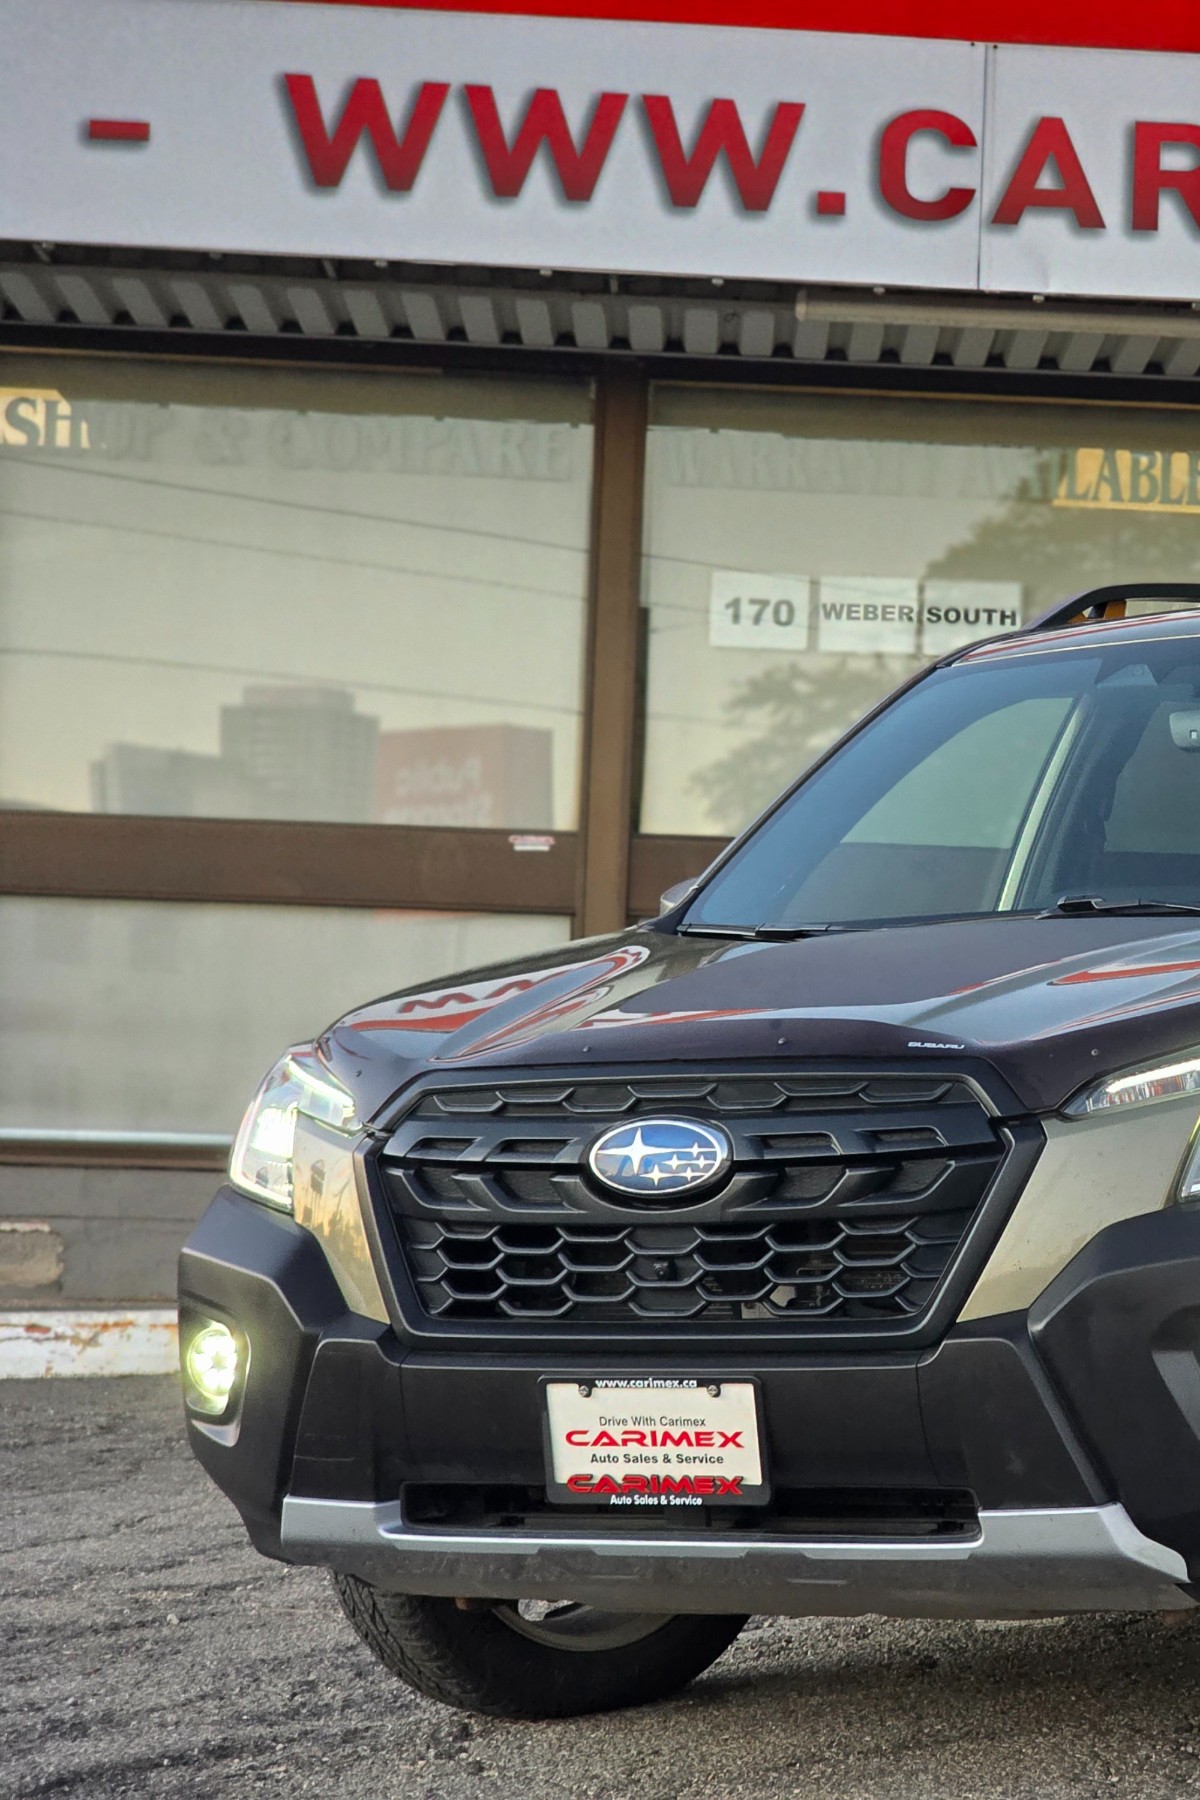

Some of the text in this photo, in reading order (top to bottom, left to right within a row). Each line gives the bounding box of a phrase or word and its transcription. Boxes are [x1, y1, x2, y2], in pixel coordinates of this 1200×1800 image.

[268, 413, 574, 480] COMPARE
[725, 598, 795, 627] 170
[822, 602, 1018, 628] WEBER SOUTH
[907, 1041, 965, 1050] SUBARU
[595, 1378, 698, 1389] www.carimex.ca
[599, 1416, 706, 1427] Drive With Carimex
[565, 1430, 744, 1448] CARIMEX
[590, 1453, 724, 1465] Auto Sales & Service
[567, 1474, 743, 1495] CARIMEX
[610, 1494, 703, 1506] Auto Sales & Service
